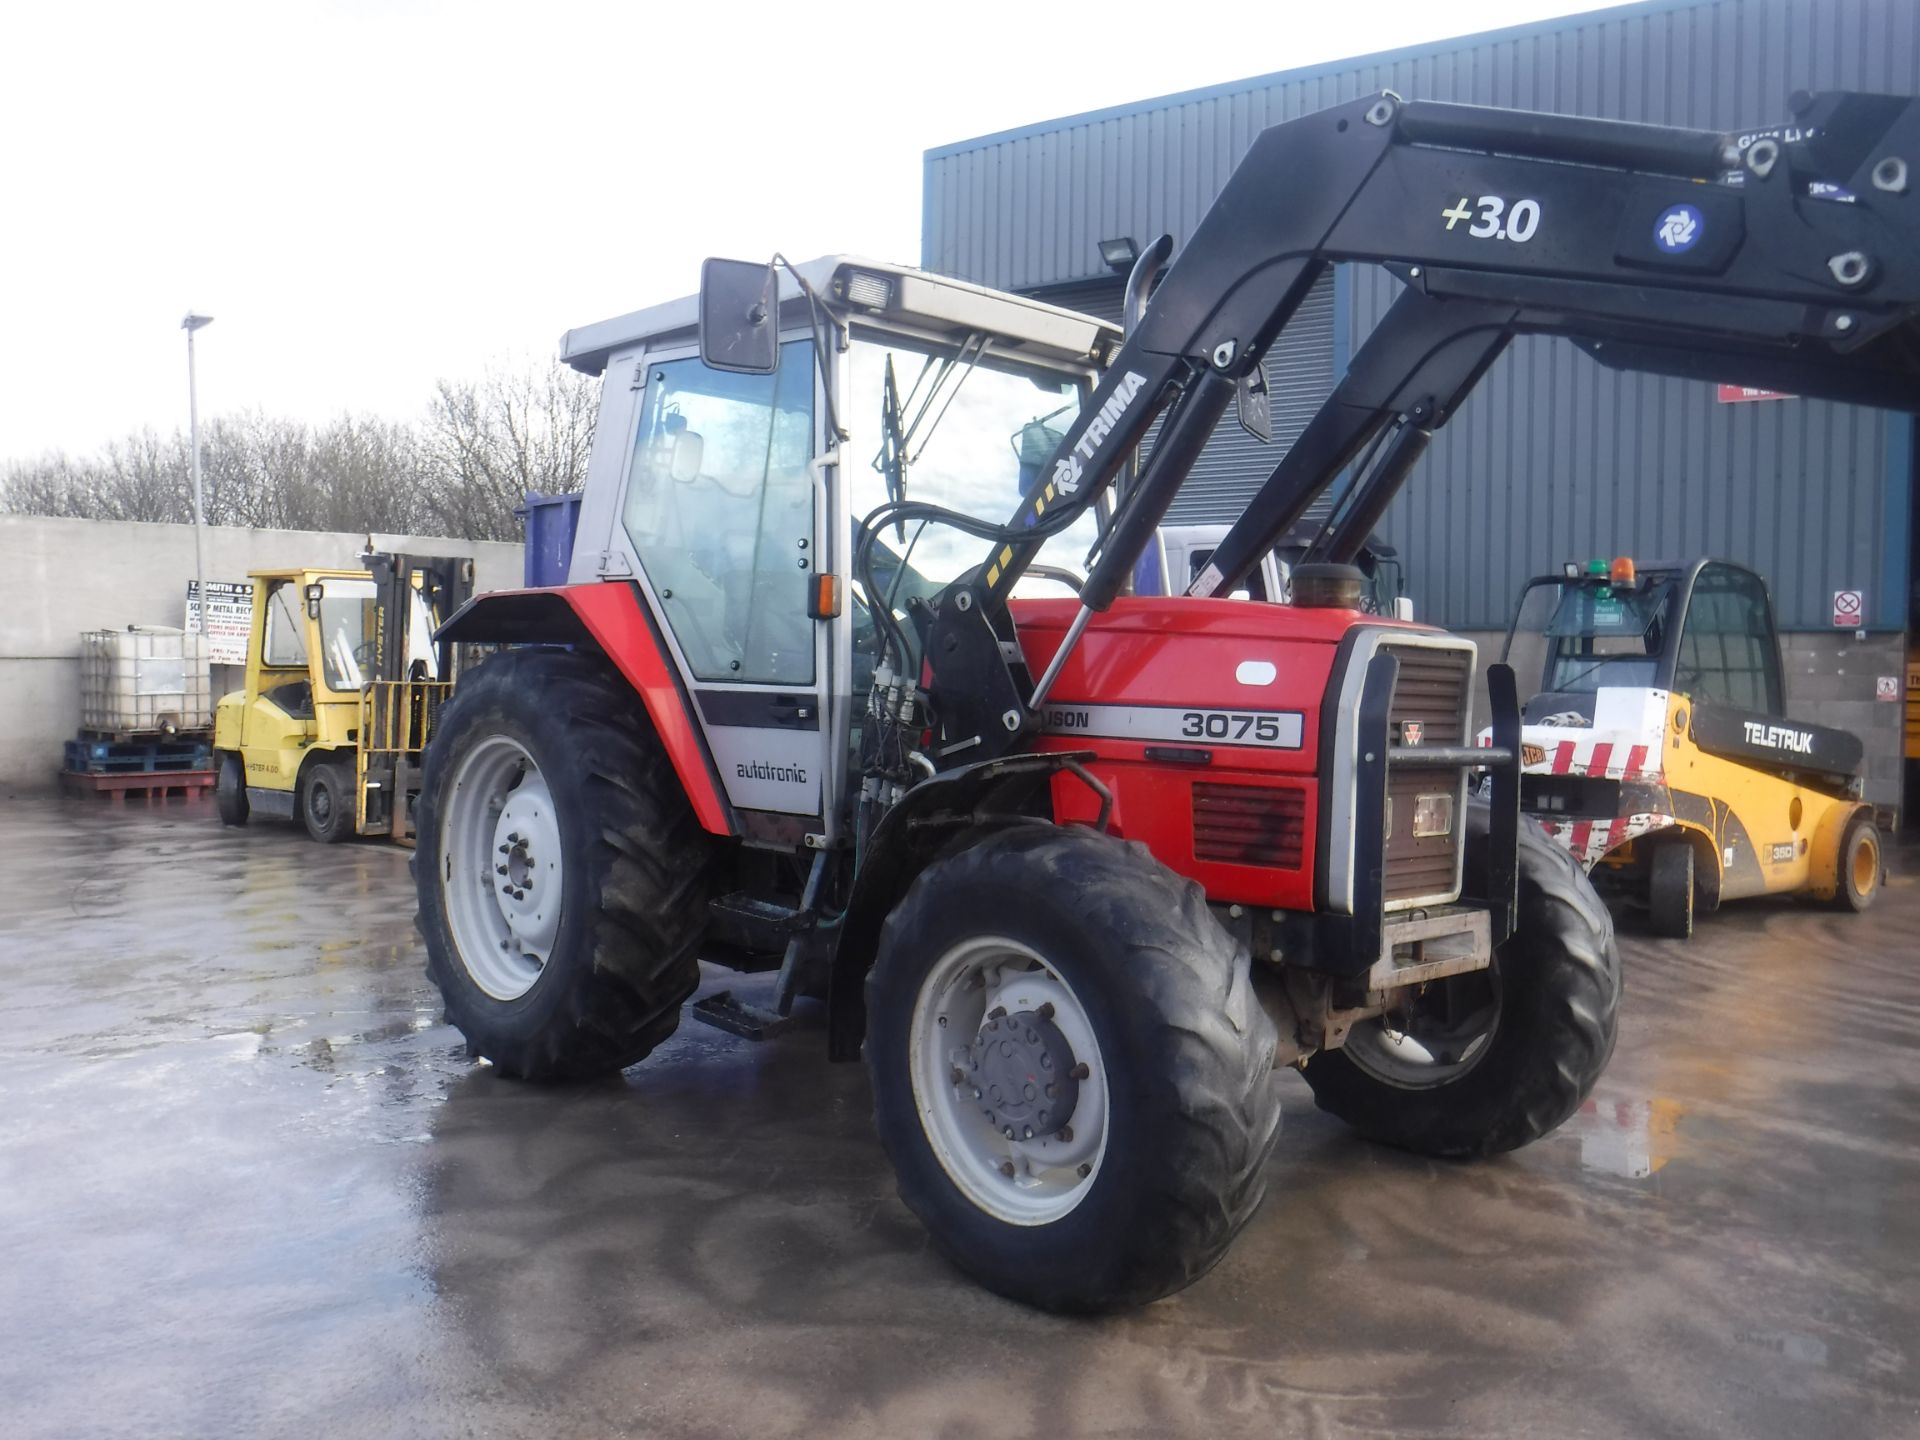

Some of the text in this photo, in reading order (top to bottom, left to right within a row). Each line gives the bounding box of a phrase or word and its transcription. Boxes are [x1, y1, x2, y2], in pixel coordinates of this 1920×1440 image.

[1441, 195, 1541, 243] +3.0
[1073, 370, 1148, 460] TRIMA
[206, 582, 233, 593] MITH
[213, 604, 234, 614] METAL
[376, 606, 384, 666] HYSTER
[1182, 712, 1280, 742] 3075
[1743, 720, 1813, 755] TELETRUK
[1522, 745, 1544, 765] JCB
[736, 759, 807, 784] autotronic
